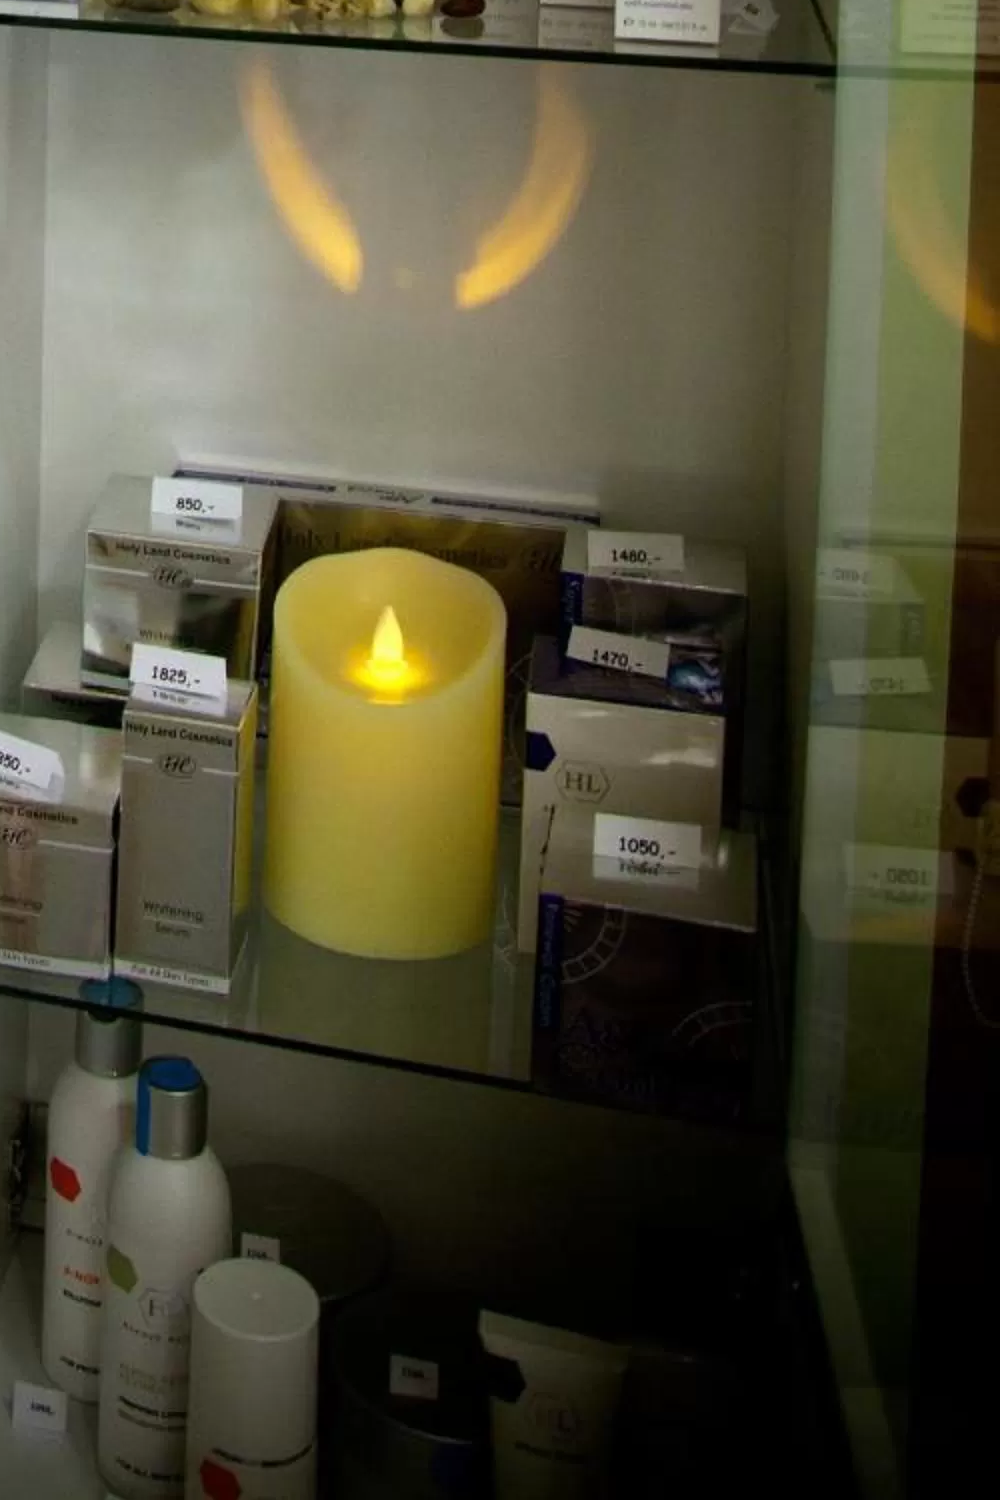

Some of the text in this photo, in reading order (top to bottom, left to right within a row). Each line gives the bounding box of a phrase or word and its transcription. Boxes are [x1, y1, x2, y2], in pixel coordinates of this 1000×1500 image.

[175, 497, 216, 514] 850,-
[611, 548, 662, 565] 1480,-
[593, 648, 644, 672] 1470,-
[151, 665, 201, 688] 1825,-
[564, 770, 601, 794] HL
[619, 835, 677, 860] 1050,-
